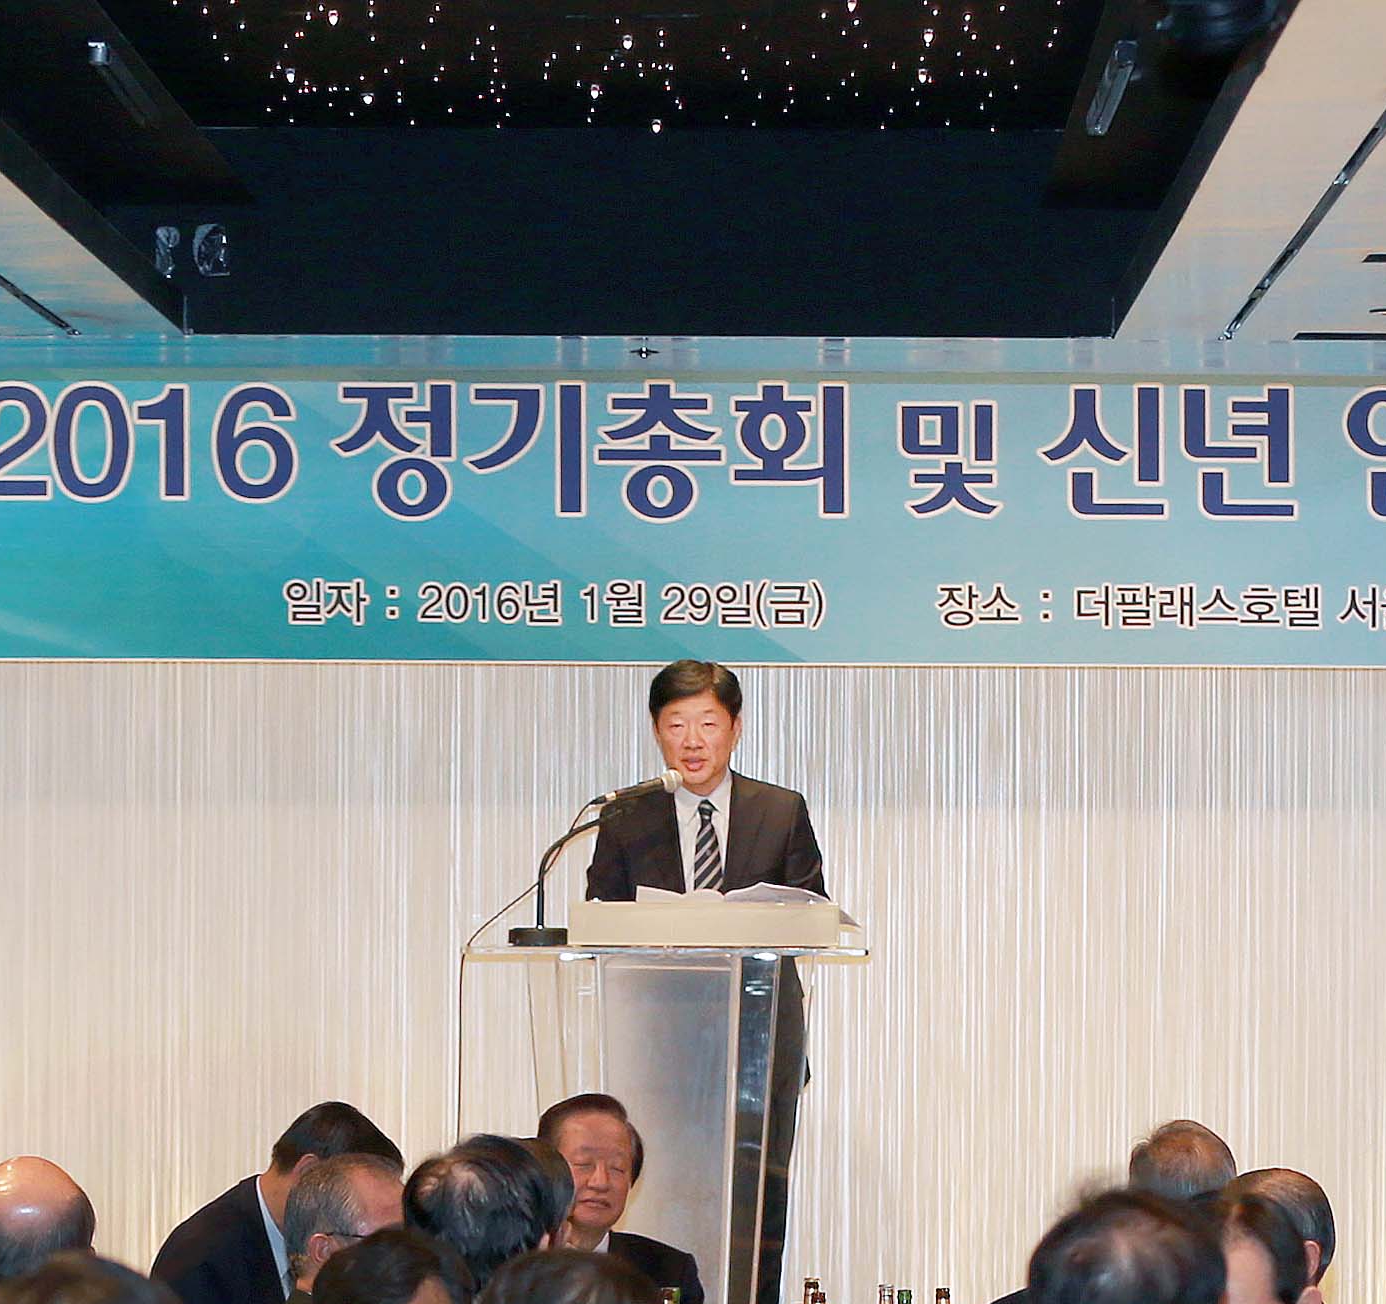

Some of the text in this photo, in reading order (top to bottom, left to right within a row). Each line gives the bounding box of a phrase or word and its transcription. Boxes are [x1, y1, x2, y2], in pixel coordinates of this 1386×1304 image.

[330, 379, 848, 522] 정기총회
[898, 400, 1003, 520] 및
[1037, 383, 1299, 521] 신년
[283, 577, 826, 630] 일자 : 2016년 1월 29일(금)
[936, 582, 1020, 628] 장소
[1038, 589, 1053, 622] :
[1074, 583, 1322, 629] 더팔래스호텔
